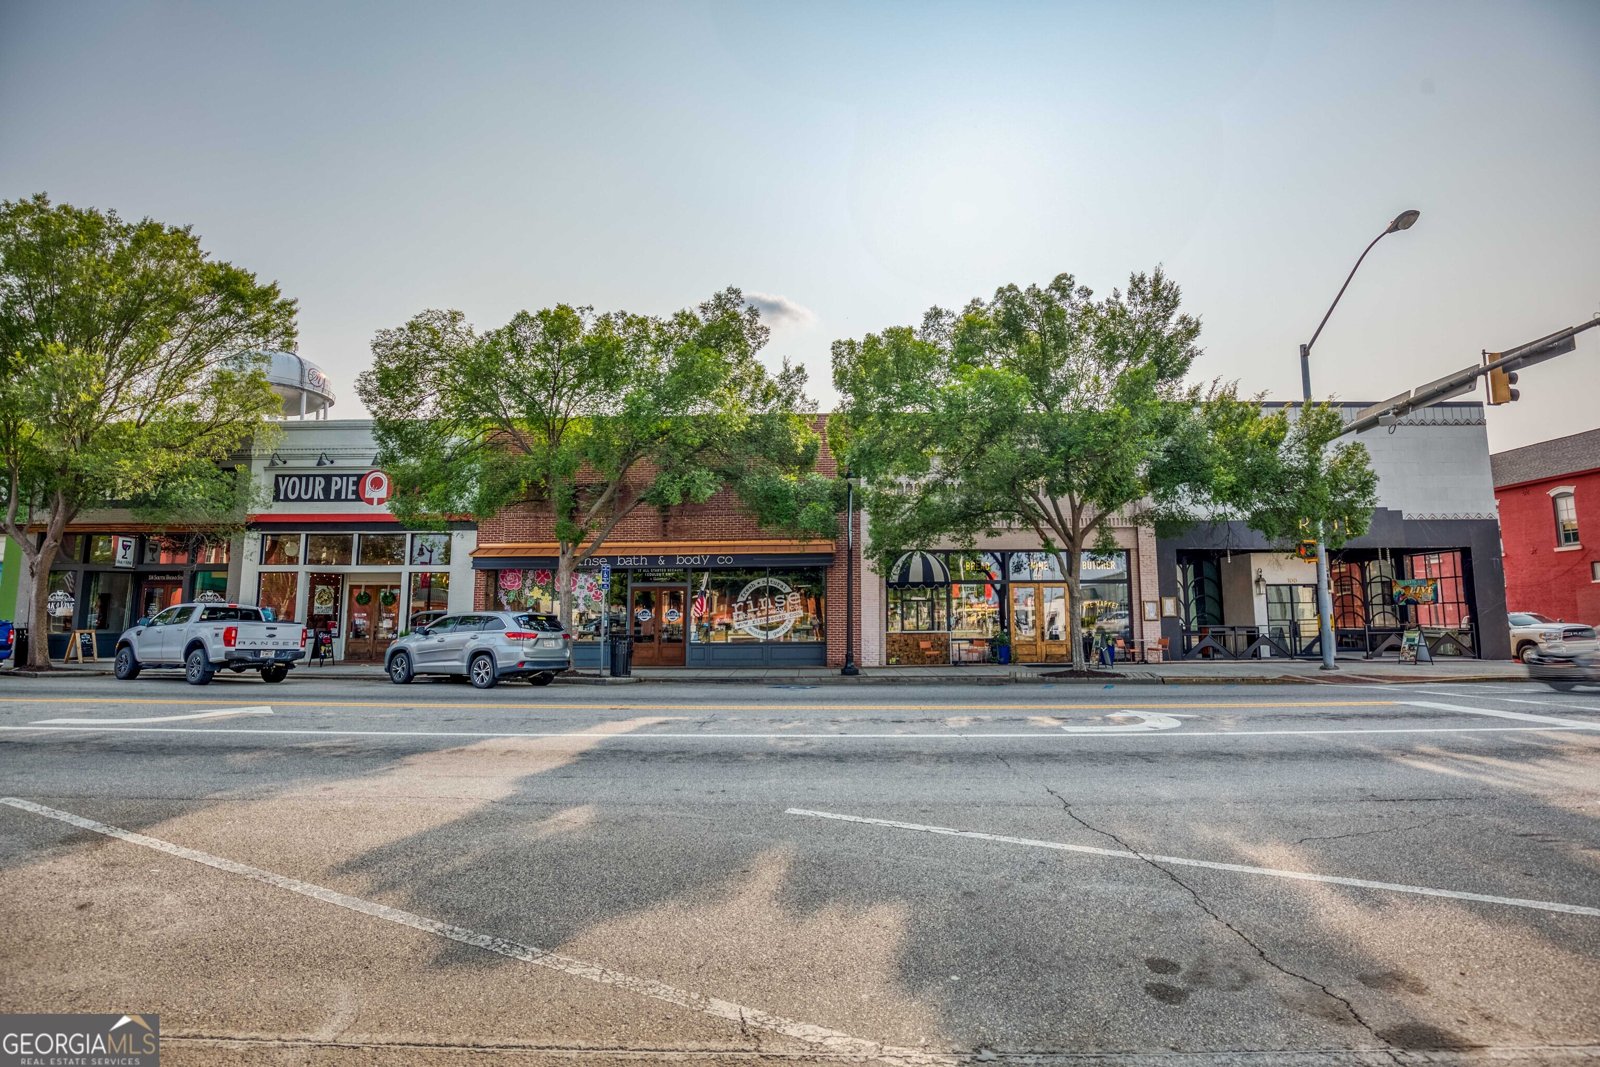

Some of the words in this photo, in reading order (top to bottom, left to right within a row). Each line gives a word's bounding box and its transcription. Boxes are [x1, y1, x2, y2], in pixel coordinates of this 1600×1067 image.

[278, 476, 325, 500] YOUR
[329, 476, 358, 500] PIE
[617, 555, 648, 566] bath
[658, 556, 665, 565] &
[675, 555, 710, 566] body
[716, 555, 734, 565] co
[1082, 560, 1116, 570] BUTCHER
[1410, 586, 1434, 594] LIVE
[732, 592, 801, 614] rinse
